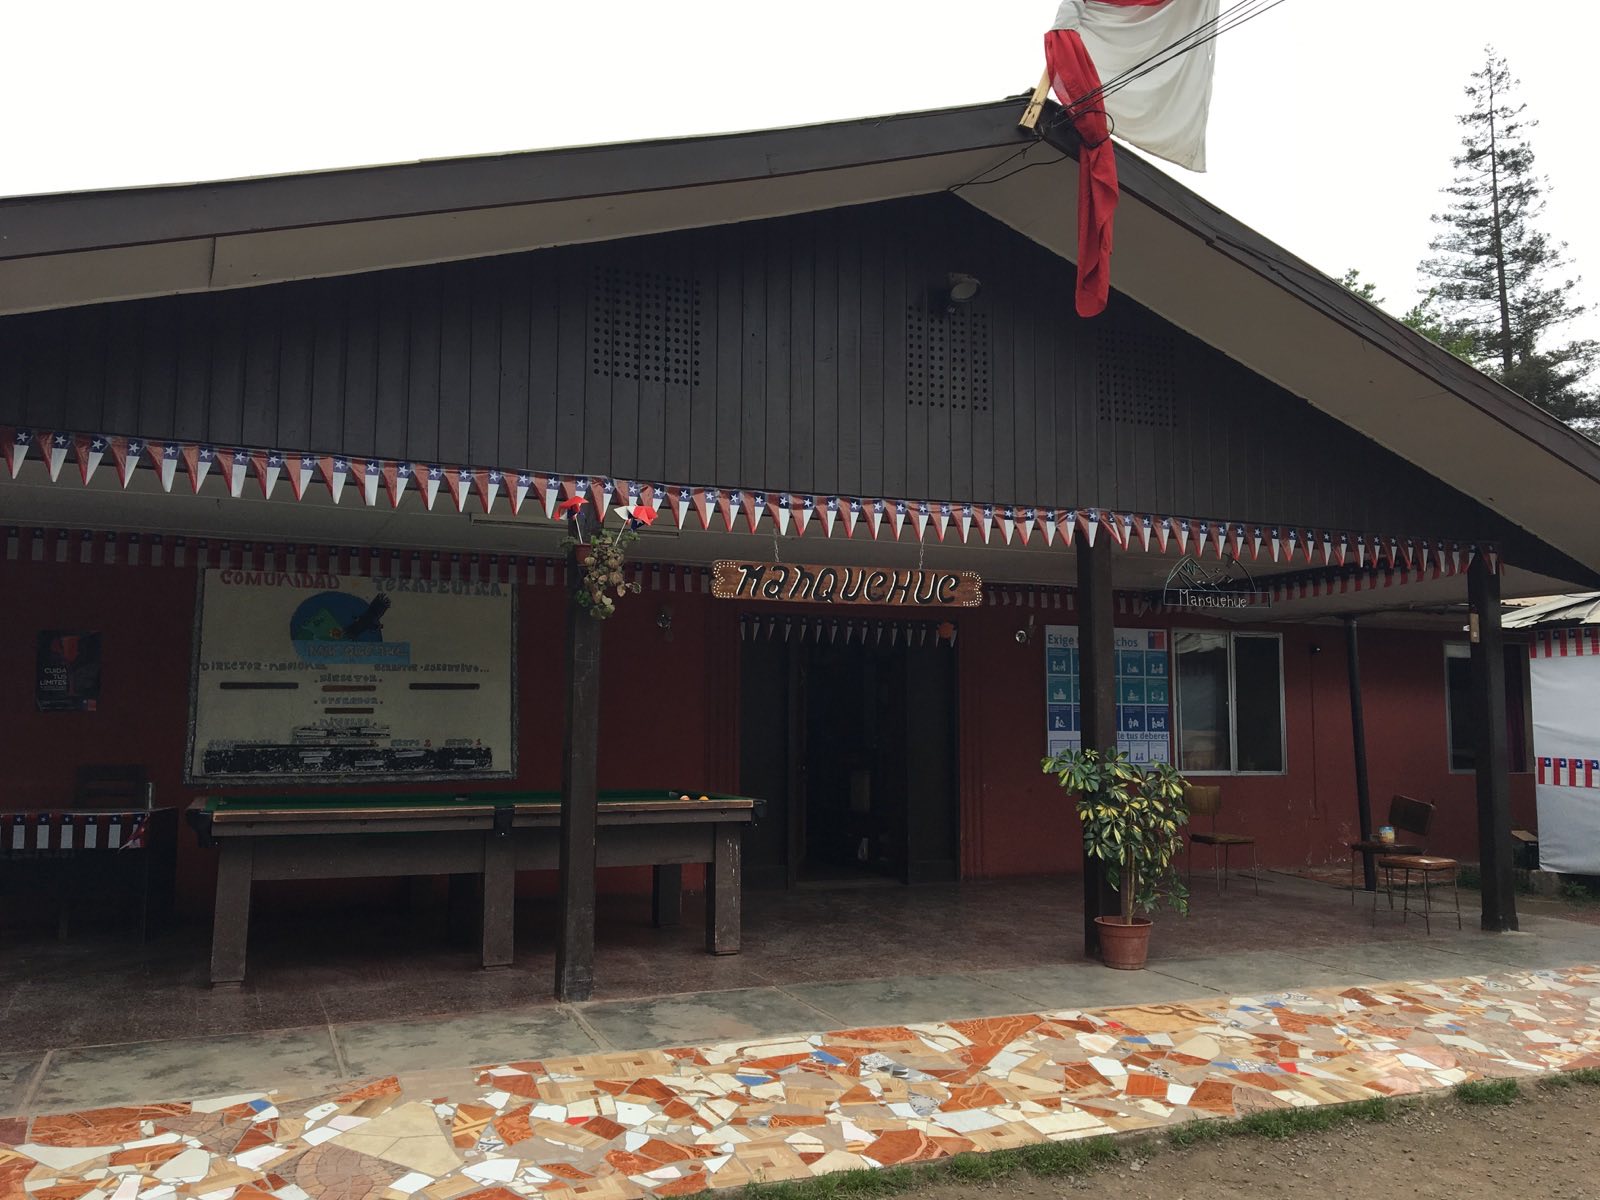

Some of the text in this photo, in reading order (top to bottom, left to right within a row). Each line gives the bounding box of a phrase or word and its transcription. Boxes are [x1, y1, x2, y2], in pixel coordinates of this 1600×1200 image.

[220, 570, 340, 589] COMUNIDAD
[1179, 589, 1247, 607] Manquehue
[1048, 634, 1138, 647] Exige chos
[1140, 732, 1169, 740] deberes
